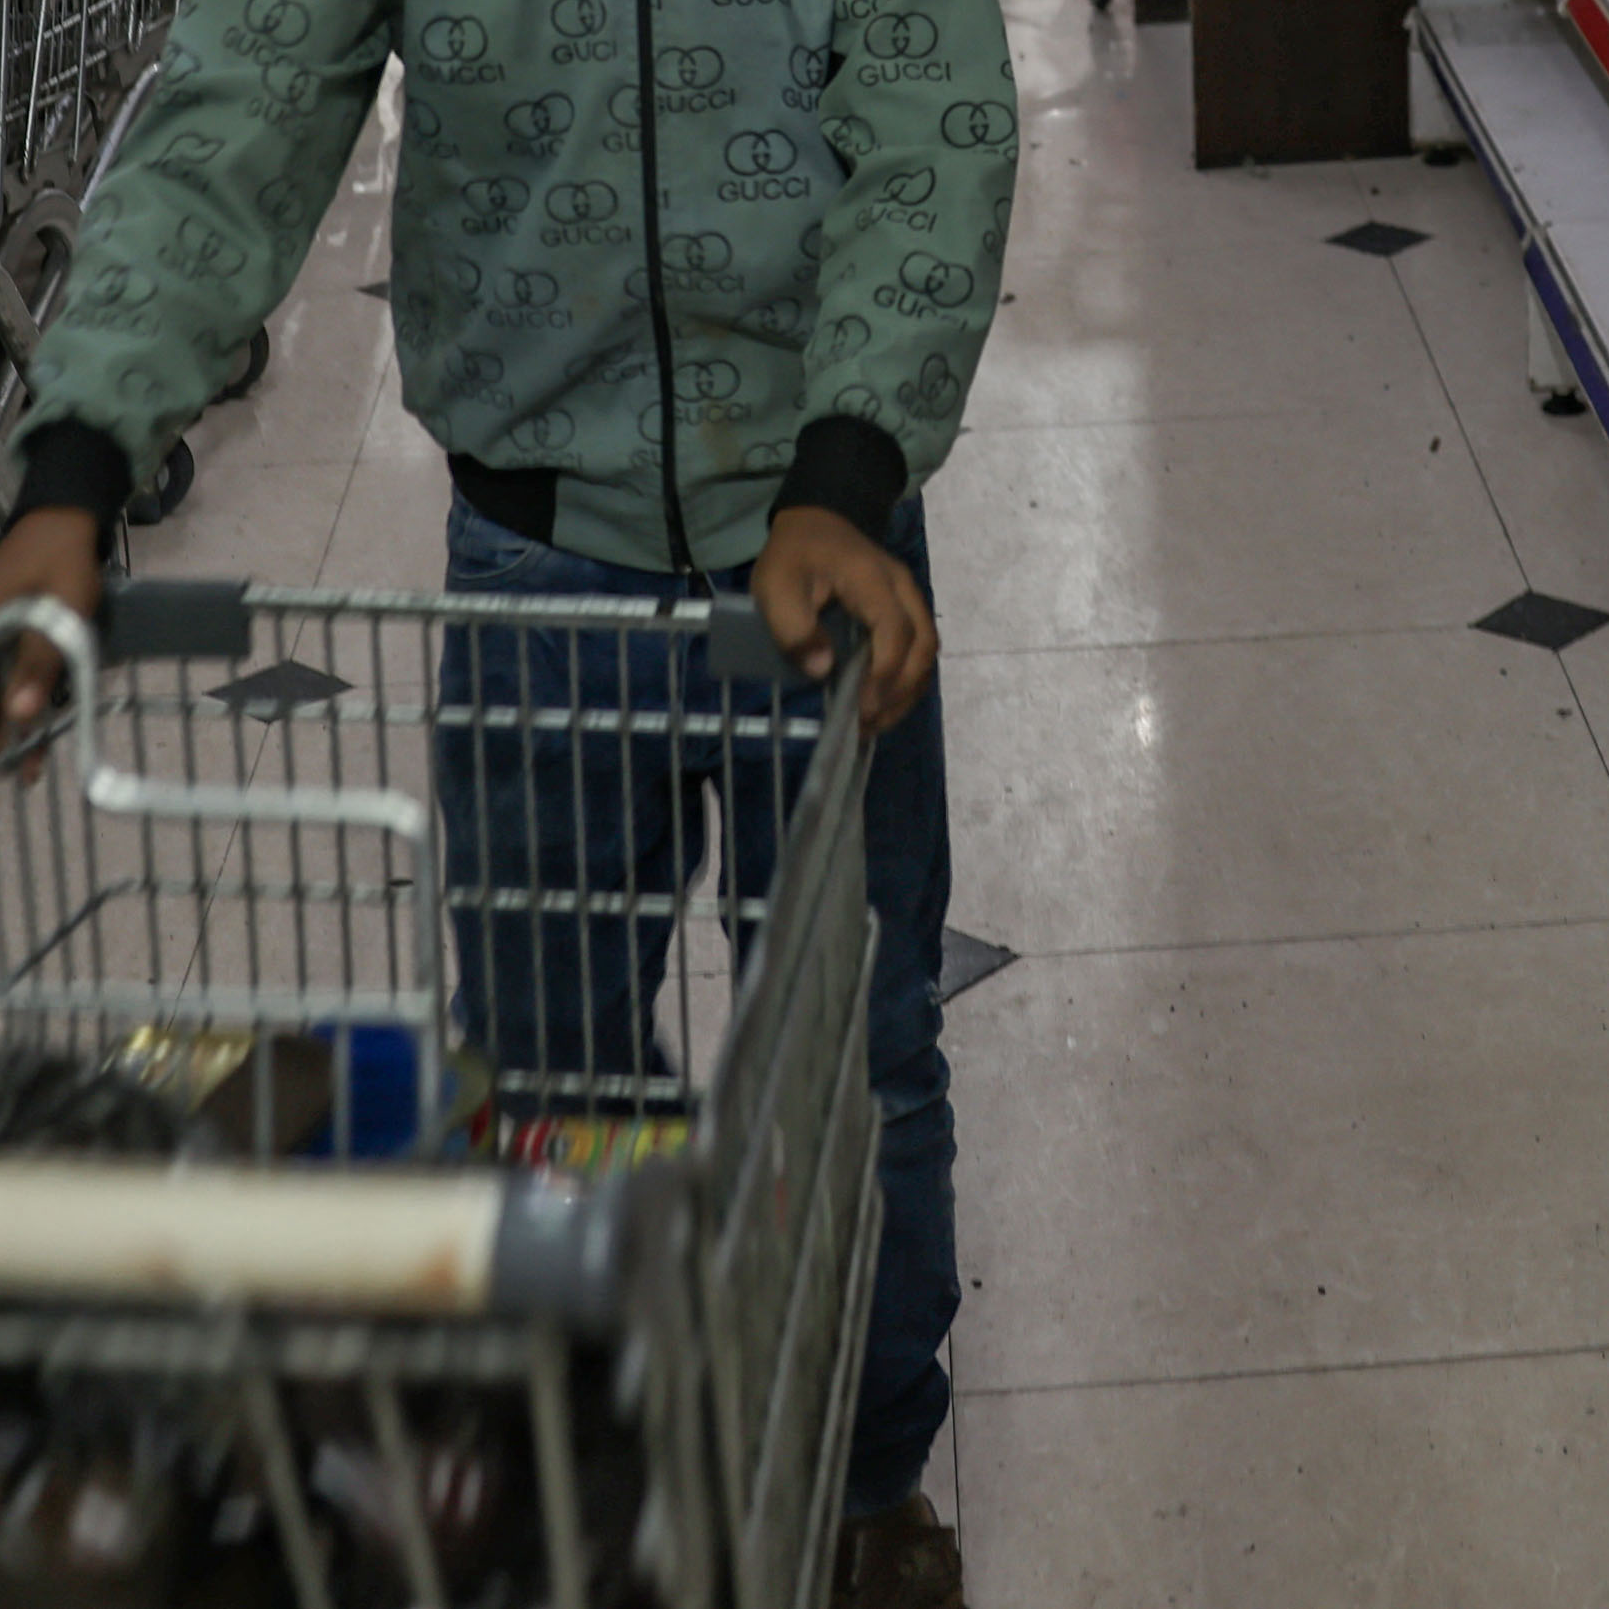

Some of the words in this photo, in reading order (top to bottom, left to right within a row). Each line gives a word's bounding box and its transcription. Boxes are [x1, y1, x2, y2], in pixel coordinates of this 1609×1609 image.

[857, 61, 951, 88] GUCCI
[717, 176, 810, 202] GUCCI
[541, 224, 632, 248] GUCCI
[486, 309, 573, 329] GUCCI
